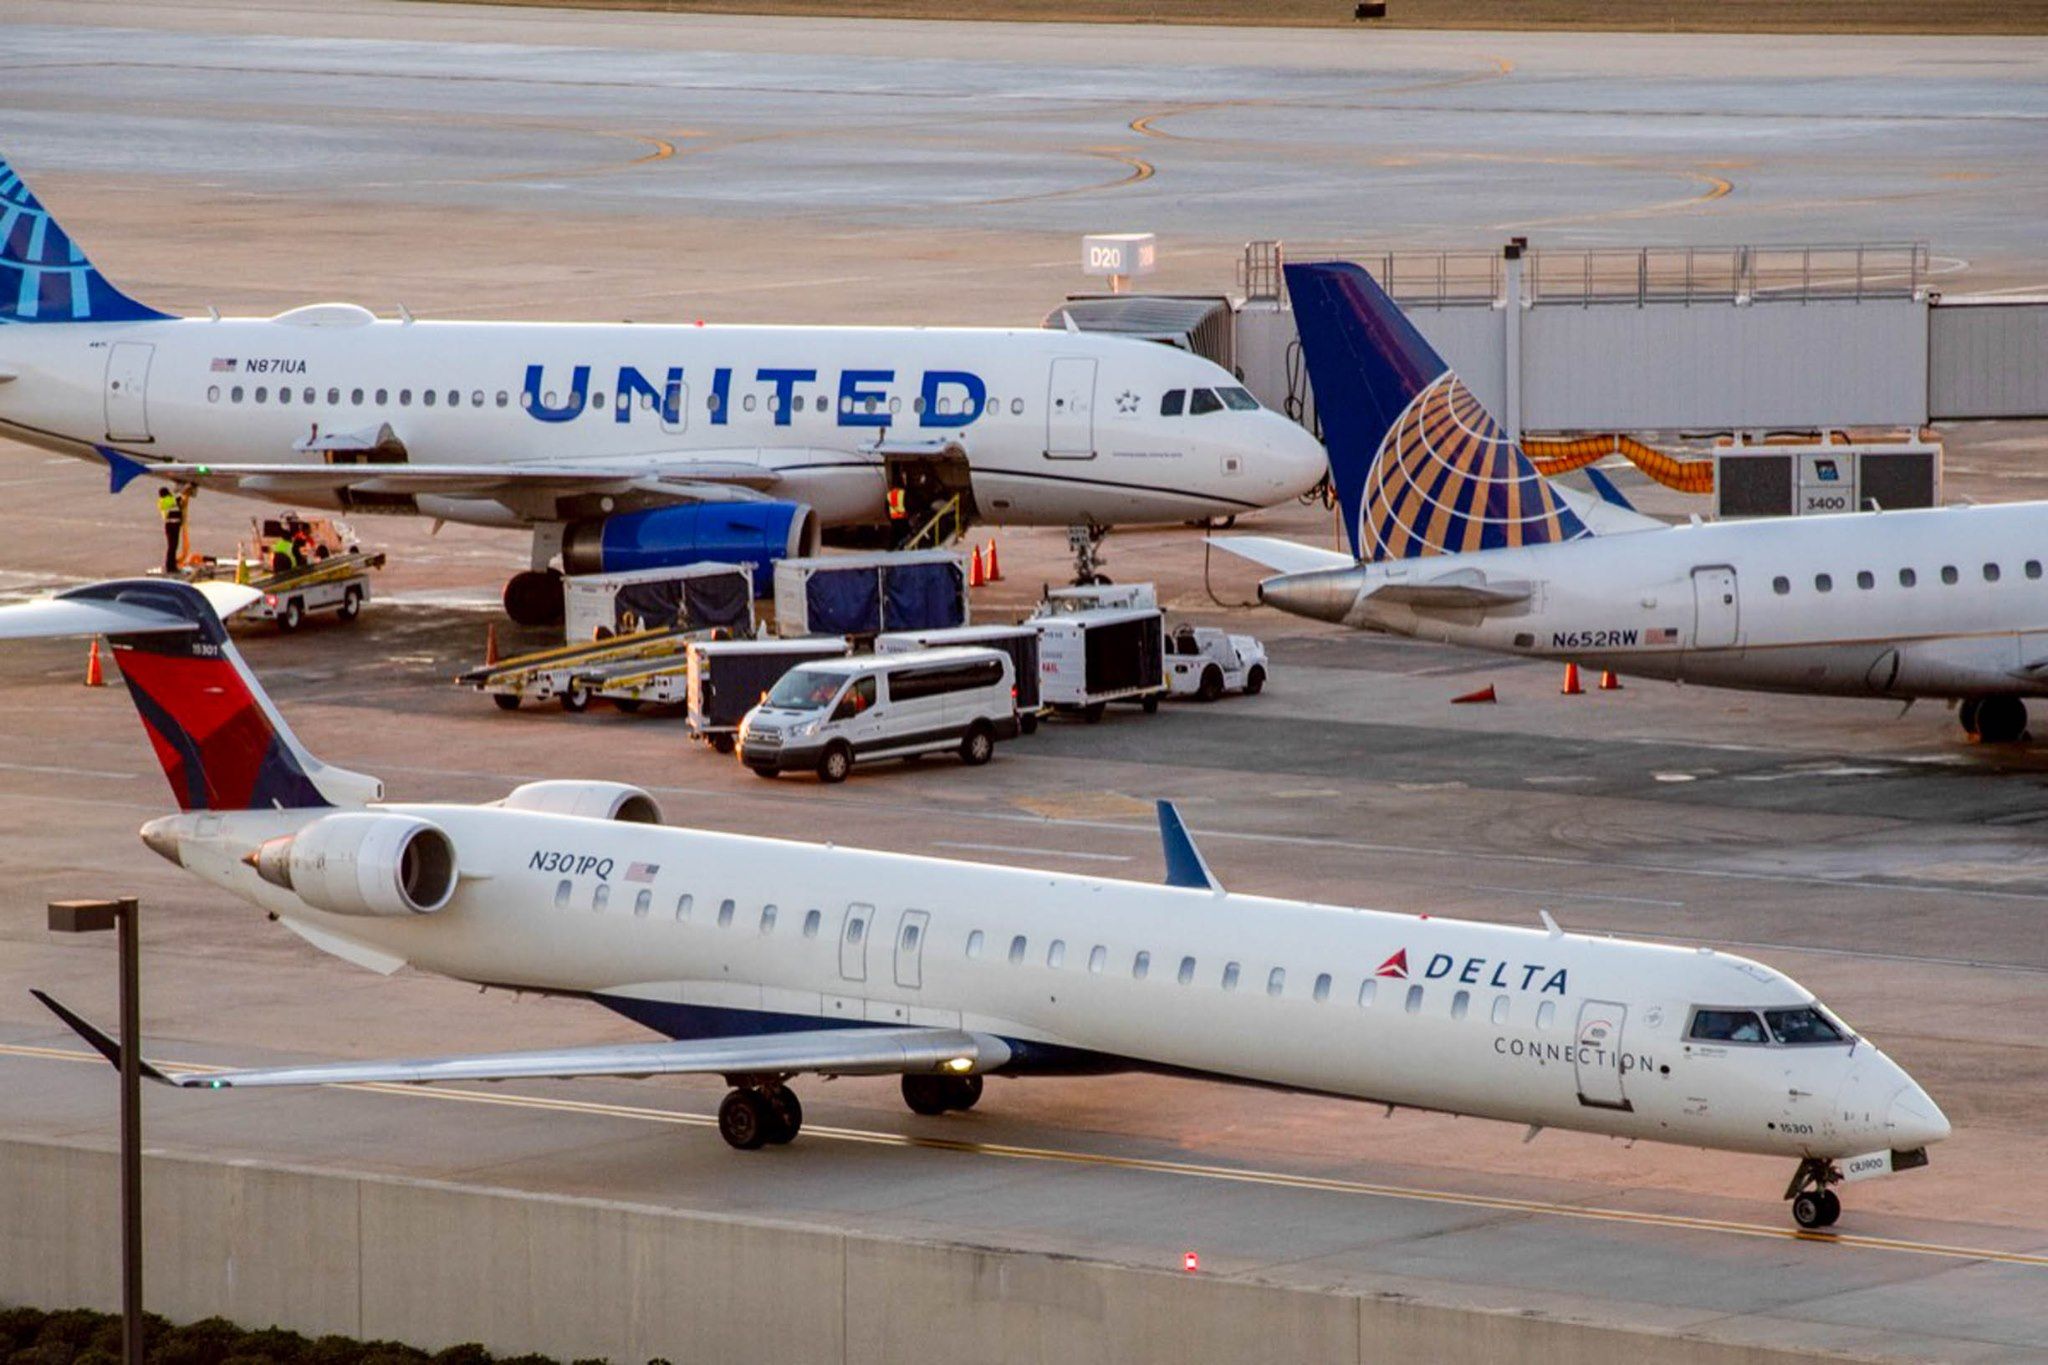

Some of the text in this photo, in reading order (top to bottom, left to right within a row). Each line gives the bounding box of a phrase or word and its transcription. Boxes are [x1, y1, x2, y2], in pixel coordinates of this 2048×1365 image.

[1091, 247, 1120, 268] D20
[245, 359, 307, 373] N871UA
[524, 365, 987, 427] UNITED
[1808, 497, 1845, 510] 3400
[1552, 629, 1638, 648] N652RW
[528, 850, 614, 881] N301PQ
[1424, 953, 1568, 995] DELTA
[1494, 1036, 1654, 1072] CONNECTION
[1780, 1123, 1814, 1134] 15301
[1849, 1158, 1884, 1173] CRJ900
